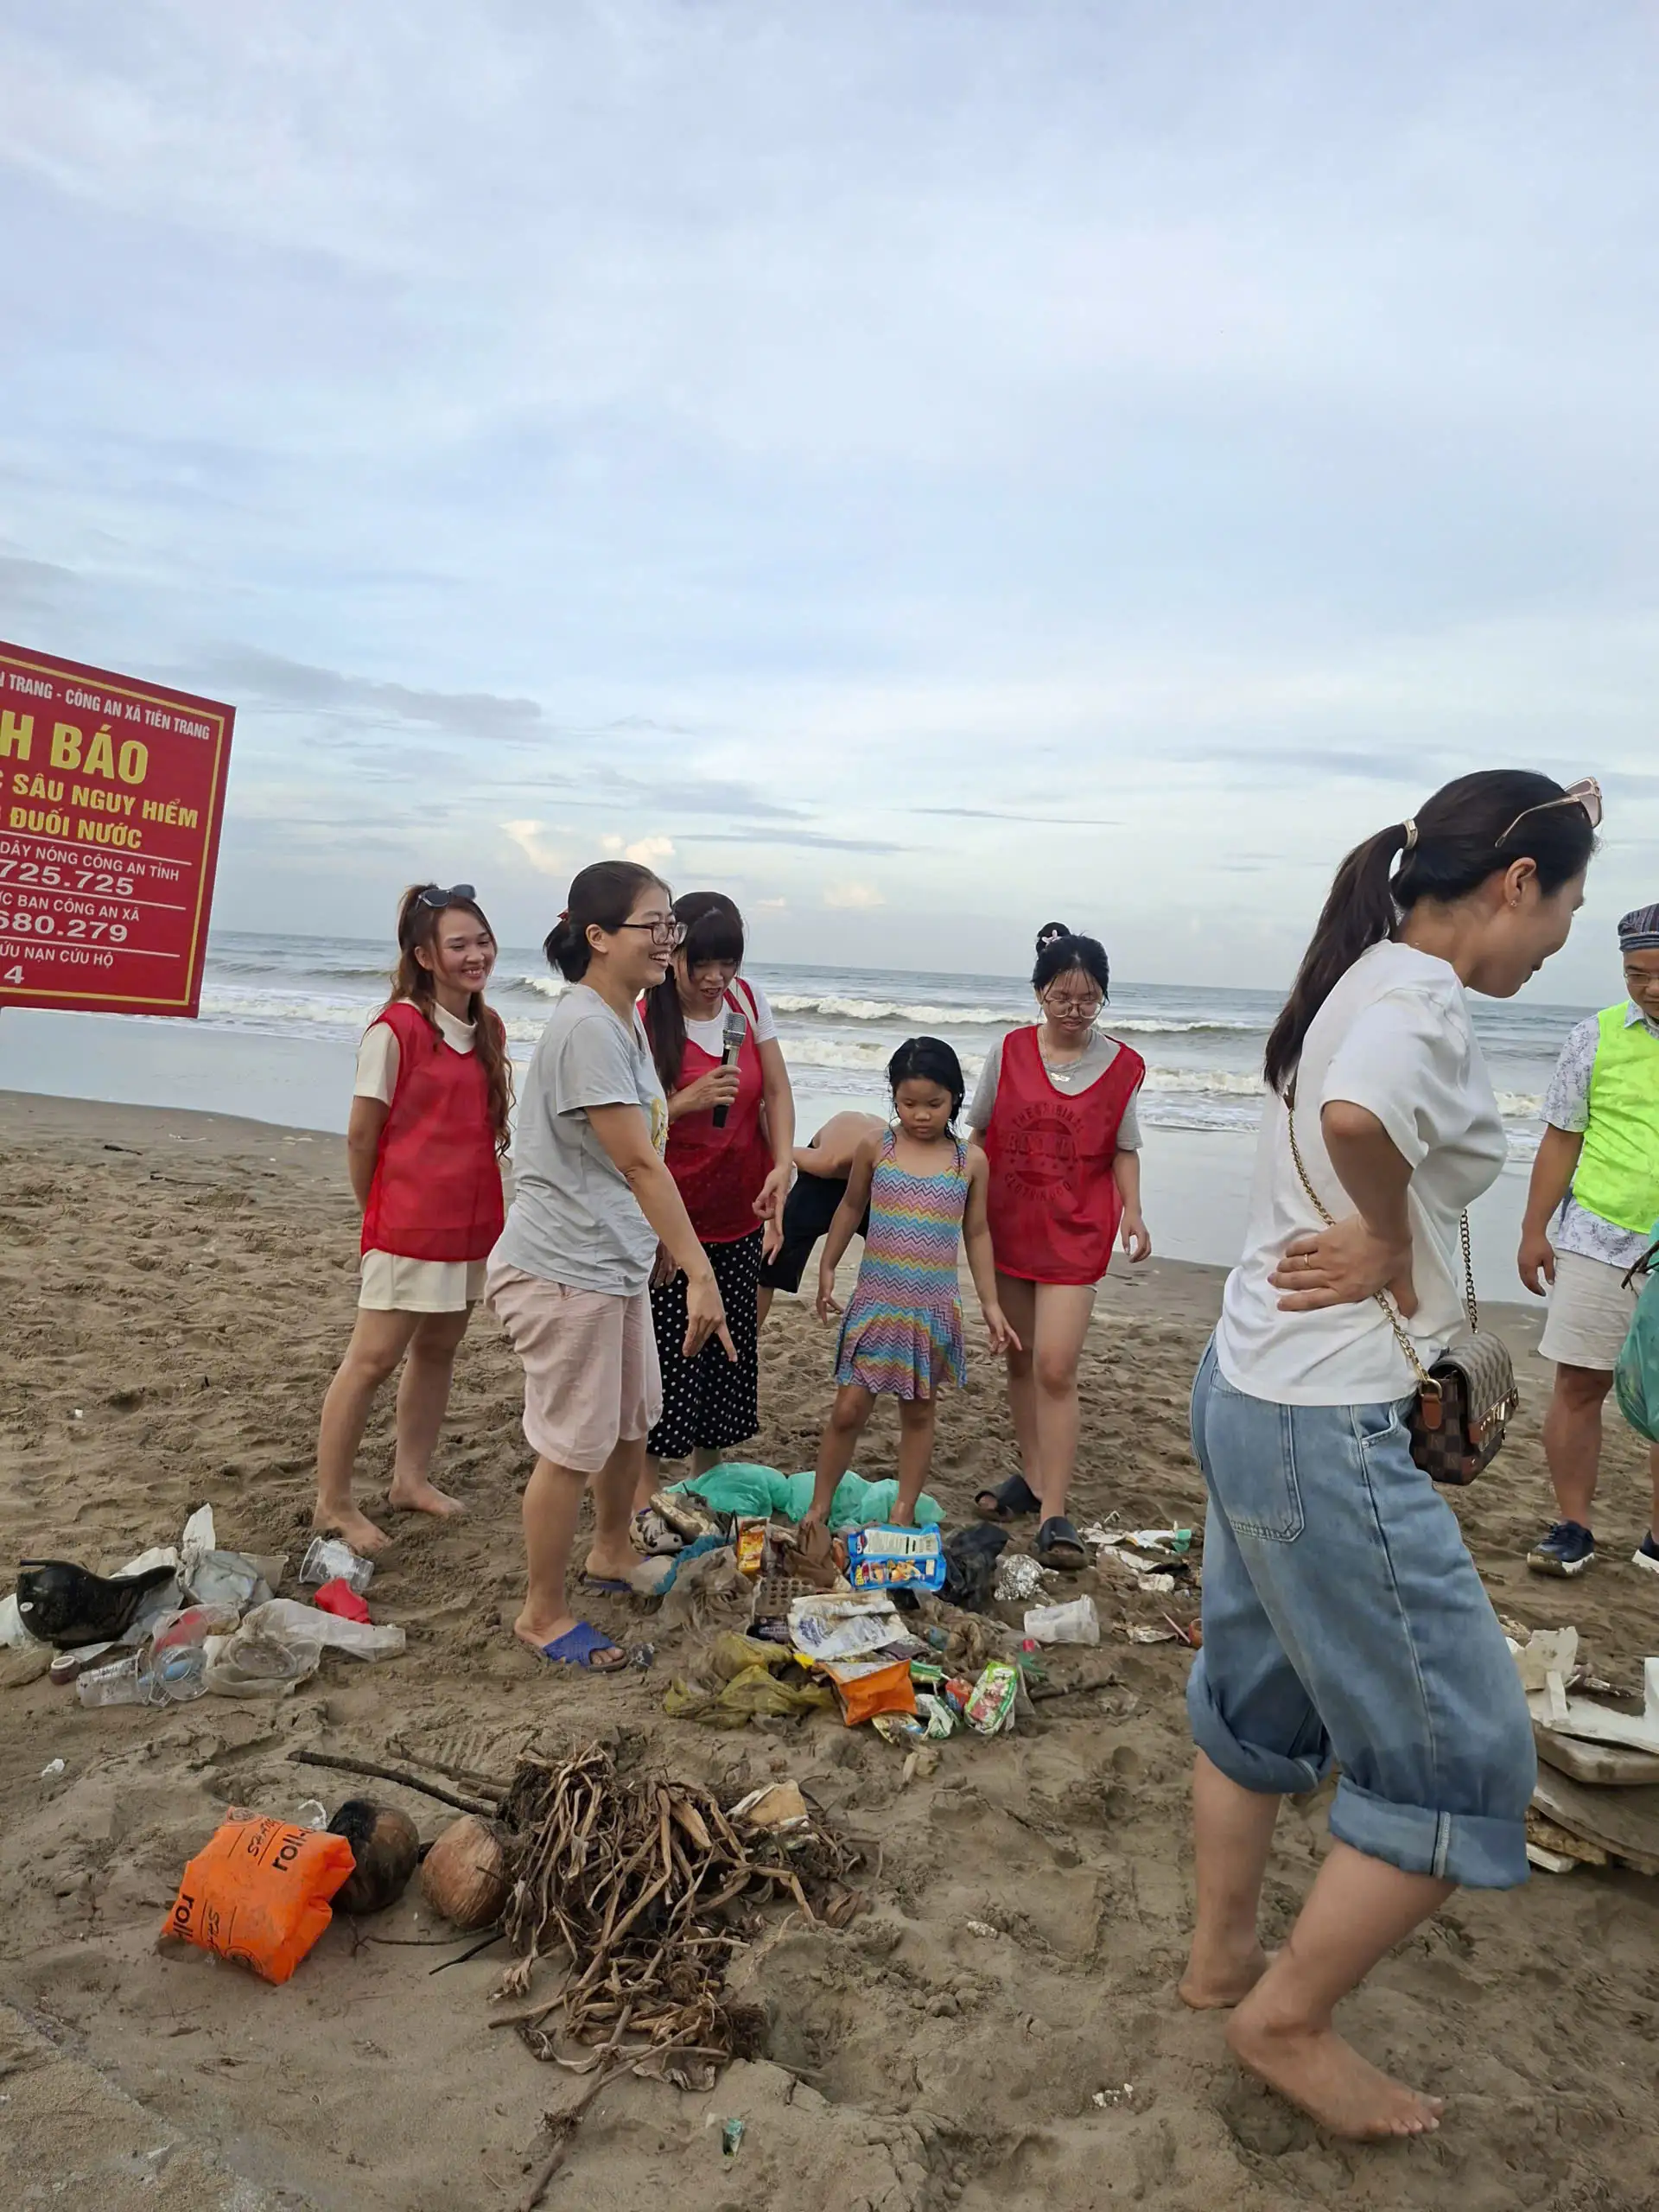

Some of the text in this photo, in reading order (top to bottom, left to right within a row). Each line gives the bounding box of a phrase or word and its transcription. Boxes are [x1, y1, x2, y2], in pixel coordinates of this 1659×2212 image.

[10, 674, 53, 700] TRANG
[66, 689, 101, 712] CÔNG
[104, 699, 122, 717] AN
[124, 704, 141, 722] XÃ
[145, 709, 171, 730] TIÊN
[174, 717, 210, 740] TRANG
[50, 722, 149, 785] BÁO
[12, 773, 64, 802] SÂU
[72, 785, 136, 816] NGUY
[142, 798, 199, 829] HIỂM
[10, 808, 143, 849] ĐUỐI NƯỚC
[0, 840, 179, 881] DÂY NÓNG CÔNG AN TỈNH
[0, 859, 134, 895] 725.725
[18, 895, 48, 910] BAN
[54, 899, 94, 915] CÔNG
[99, 906, 118, 918] AN
[122, 907, 140, 921] XÃ
[3, 965, 25, 984] 4
[24, 946, 55, 963] NẠN
[60, 949, 90, 965] CỨU
[93, 952, 114, 969] HỘ
